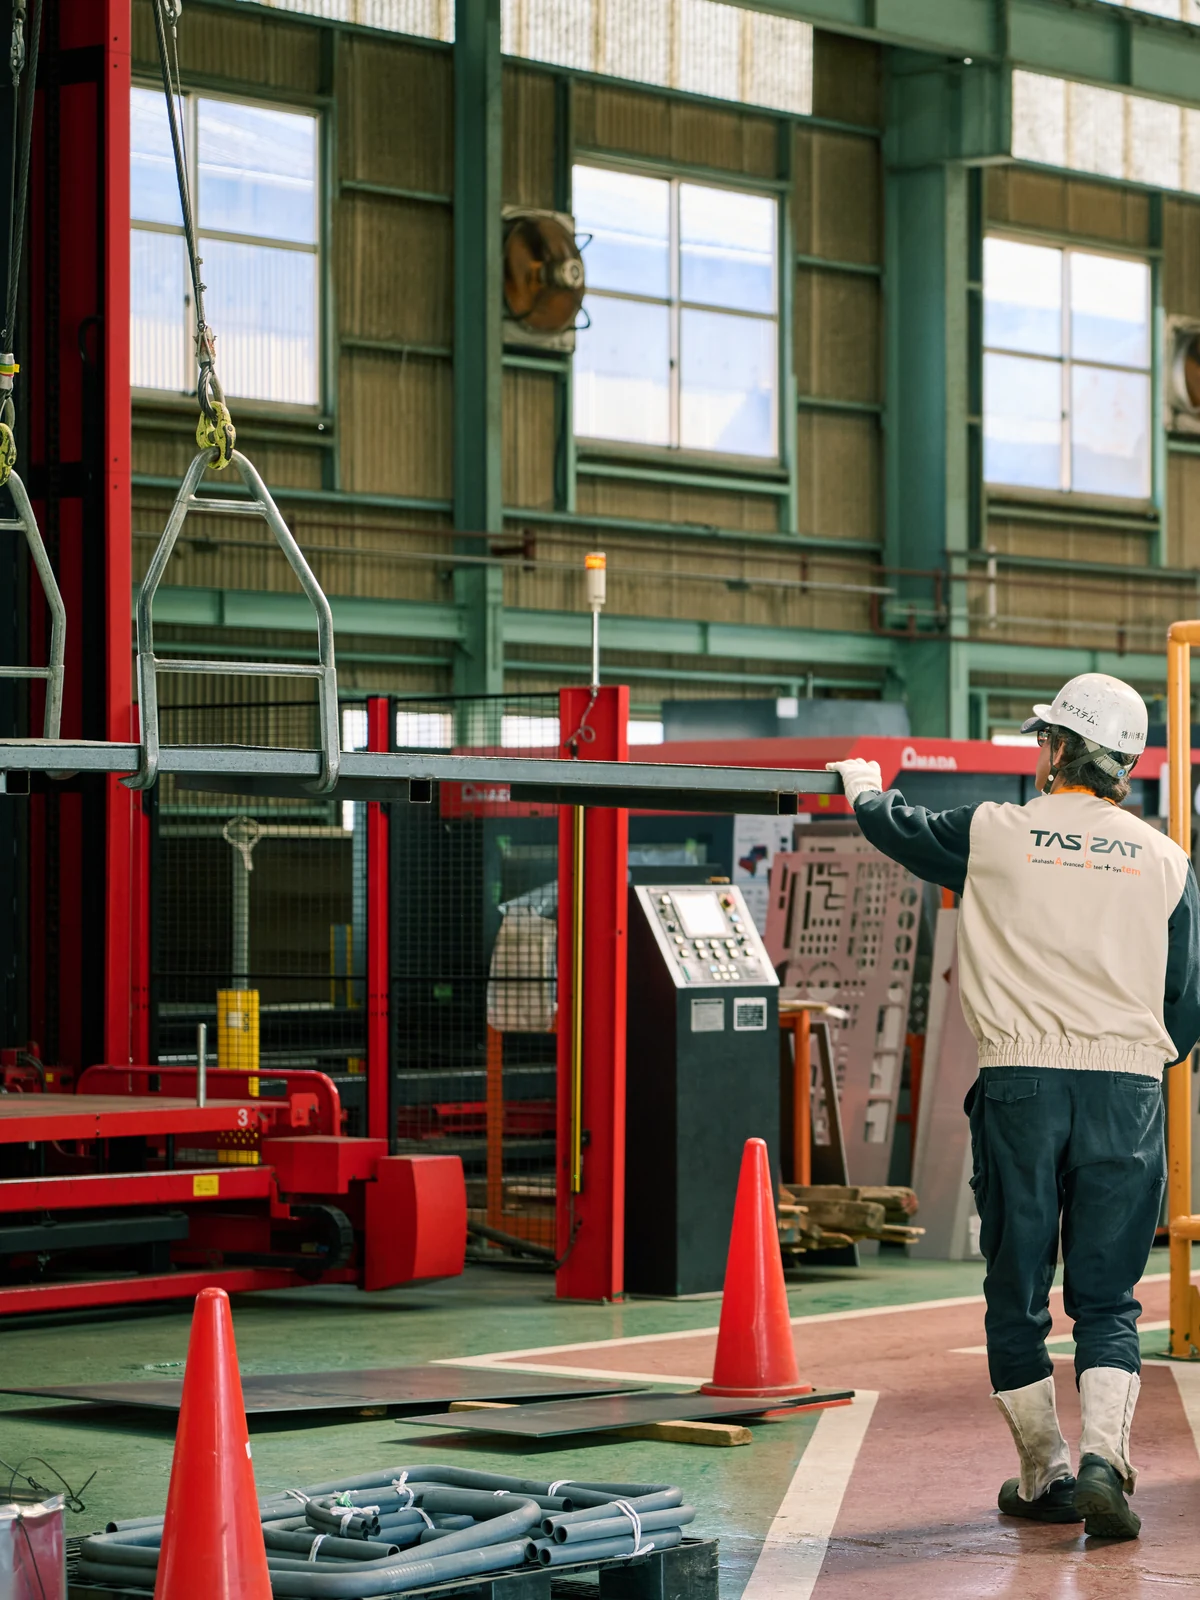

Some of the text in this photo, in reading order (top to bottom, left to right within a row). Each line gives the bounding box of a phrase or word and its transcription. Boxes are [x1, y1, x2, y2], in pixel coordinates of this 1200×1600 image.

[902, 747, 958, 770] AMADA
[1030, 830, 1082, 851] TAS
[1026, 853, 1054, 865] Takahashi
[1055, 857, 1084, 868] Advanced
[1085, 860, 1103, 870] Steel
[1112, 865, 1141, 876] System
[237, 1108, 249, 1127] 3
